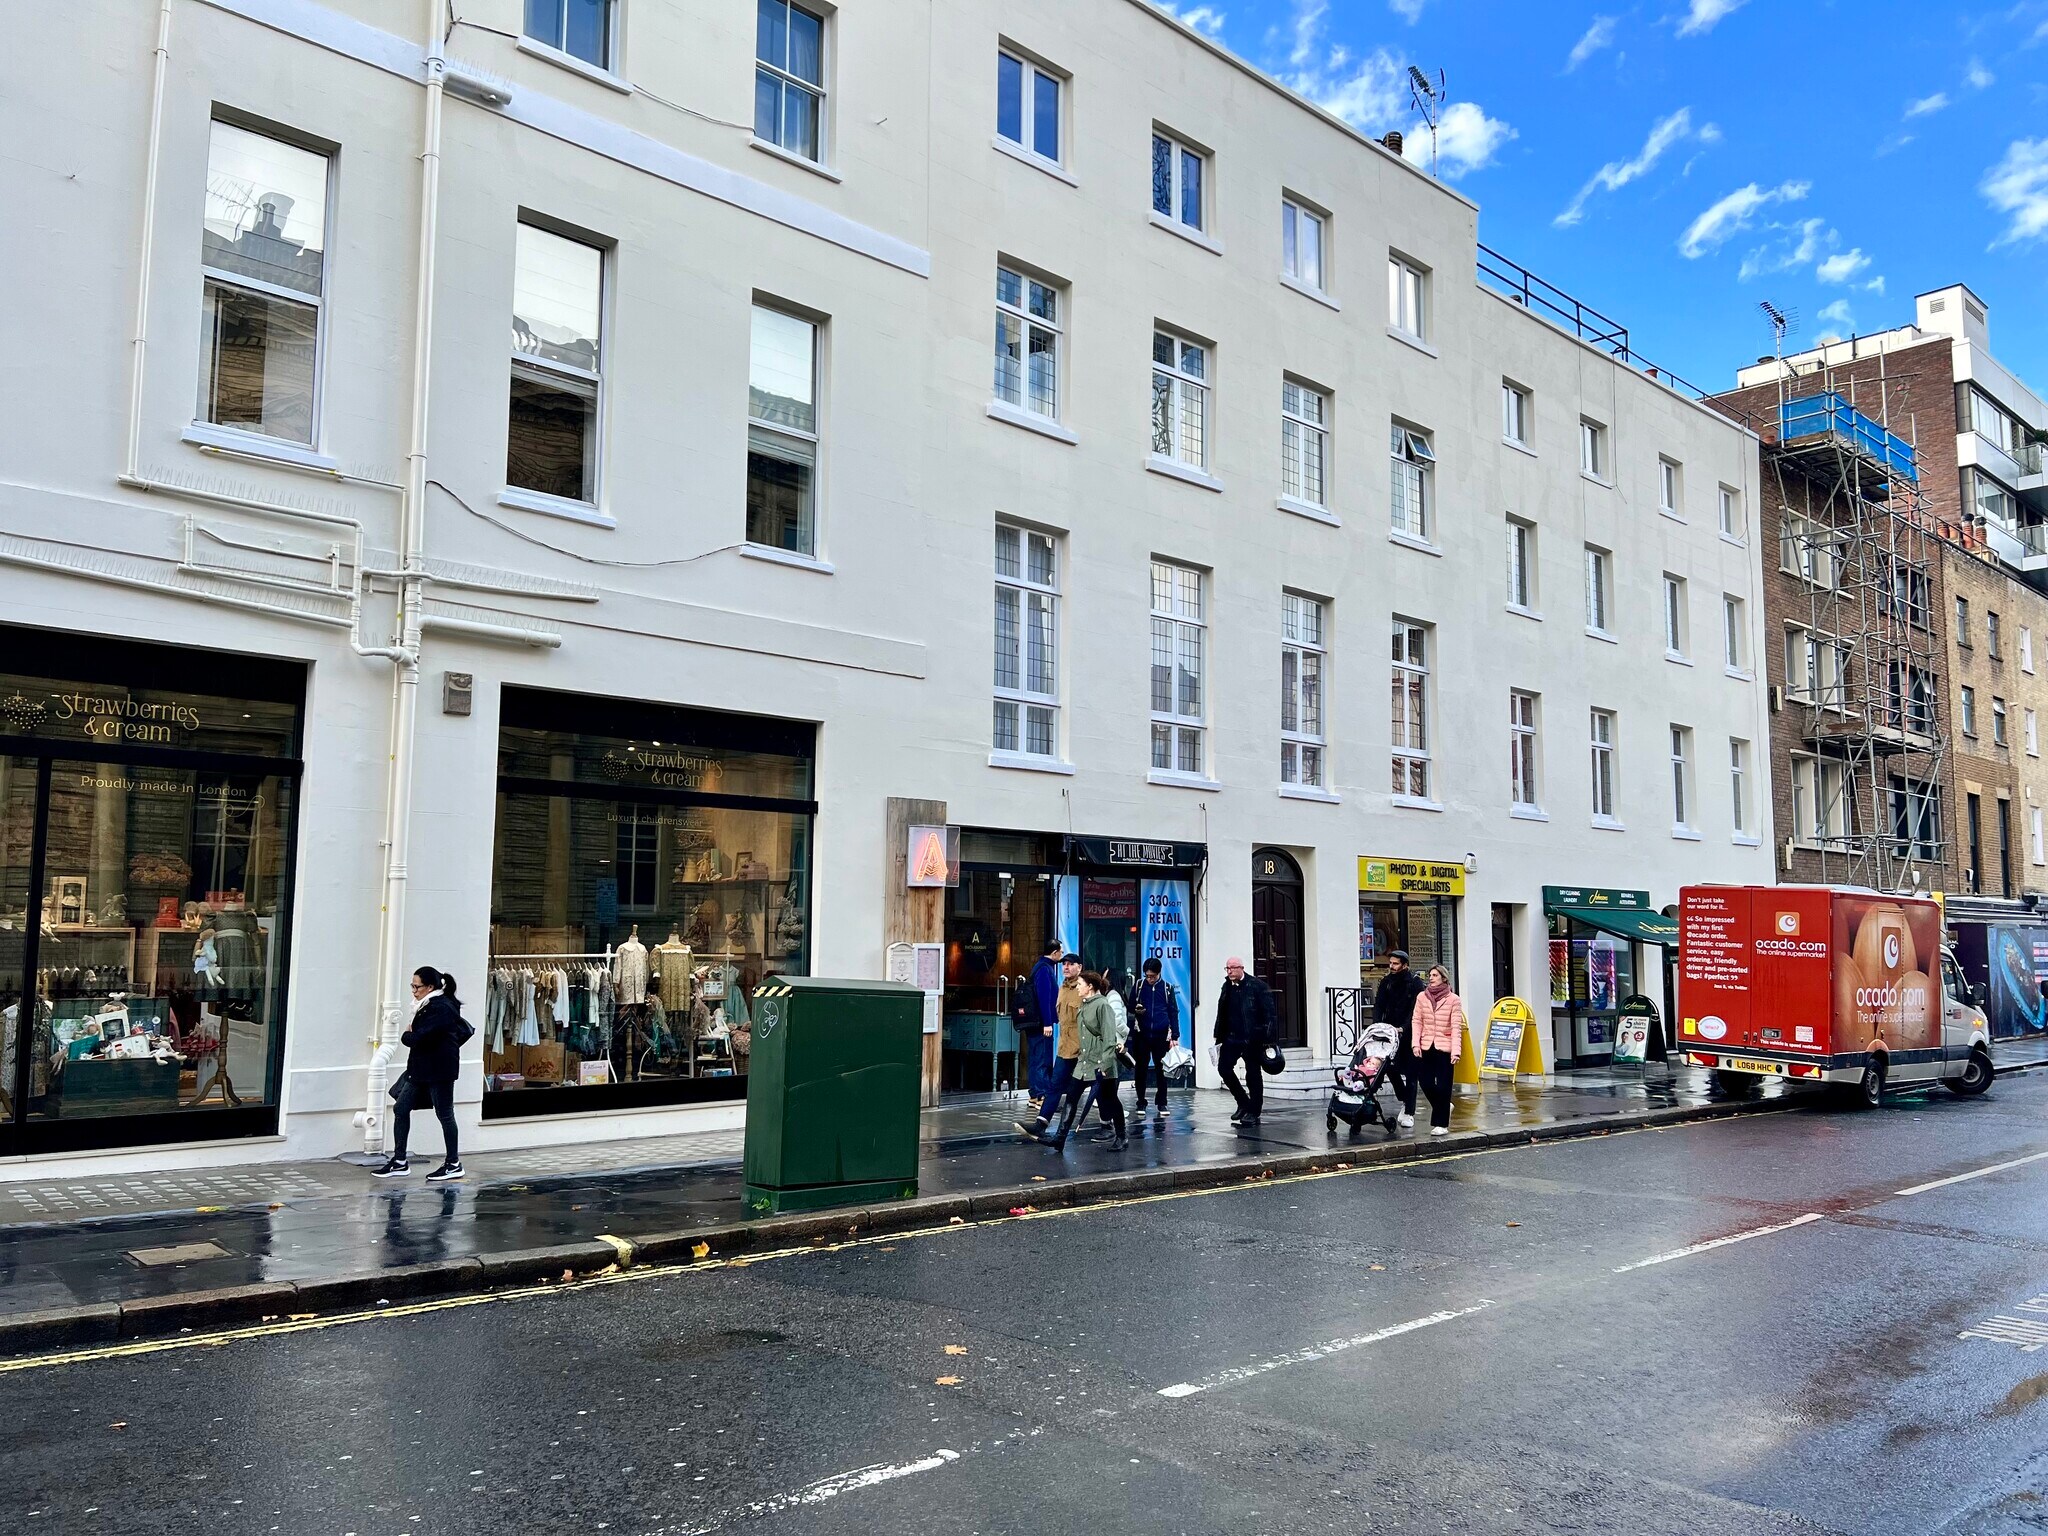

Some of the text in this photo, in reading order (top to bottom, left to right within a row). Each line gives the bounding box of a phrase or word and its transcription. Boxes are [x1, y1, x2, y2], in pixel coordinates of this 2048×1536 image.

[83, 715, 171, 742] & cream
[651, 768, 705, 788] & cream
[81, 775, 247, 798] Proudly made in London
[607, 812, 703, 827] Luxury childrenswear
[916, 832, 948, 882] A
[1128, 844, 1141, 859] THE
[1264, 860, 1275, 875] 18
[1390, 863, 1460, 879] PHOTO & DIGITAL
[1401, 879, 1451, 892] SPECIALISTS
[1149, 895, 1169, 907] 330
[1149, 912, 1182, 925] RETAIL
[971, 932, 980, 943] A
[1153, 930, 1178, 941] UNIT
[1686, 939, 1714, 947] Fantastic
[1755, 938, 1827, 951] ocado.com
[1149, 947, 1183, 959] TO LET
[1767, 949, 1786, 957] online
[1686, 956, 1713, 964] ordering,
[1714, 957, 1737, 965] friendly
[1686, 971, 1703, 979] bags!
[1704, 972, 1729, 980] #perfect
[1717, 966, 1748, 974] pre-sorted
[1856, 981, 1925, 1007] ocado.com
[1625, 1017, 1634, 1028] 5
[1857, 1011, 1868, 1023] The
[1869, 1010, 1888, 1024] online
[1736, 1060, 1772, 1072] LO68 HHC
